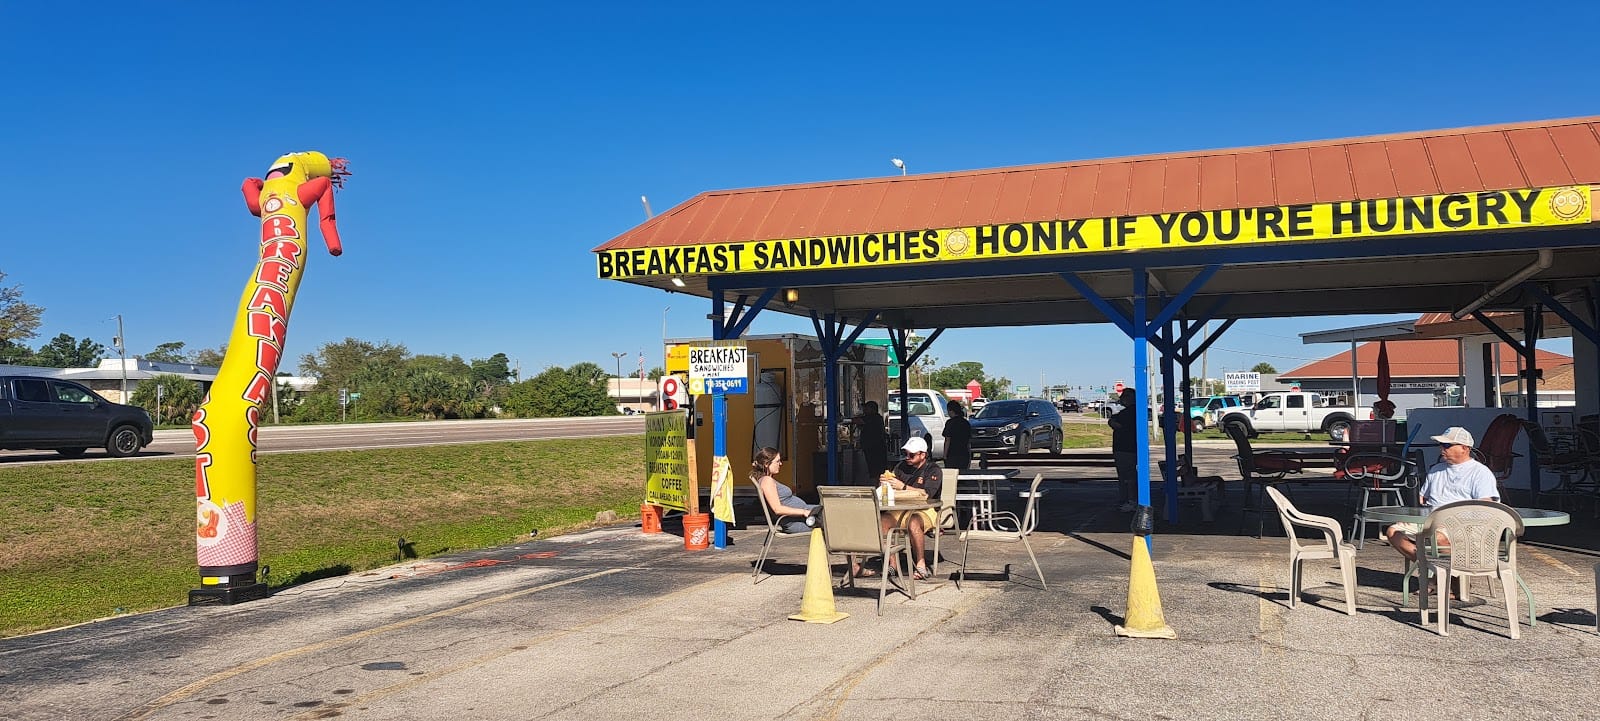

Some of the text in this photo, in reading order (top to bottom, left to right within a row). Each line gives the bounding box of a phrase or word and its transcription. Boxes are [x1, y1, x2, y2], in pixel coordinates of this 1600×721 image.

[599, 187, 1543, 278] BREAKFAST SANDWICHES HONK IF YOU'RE HUNGRY
[690, 348, 747, 364] BREAKFAST
[694, 364, 735, 372] SANDWICHES
[661, 478, 683, 491] COFFEE
